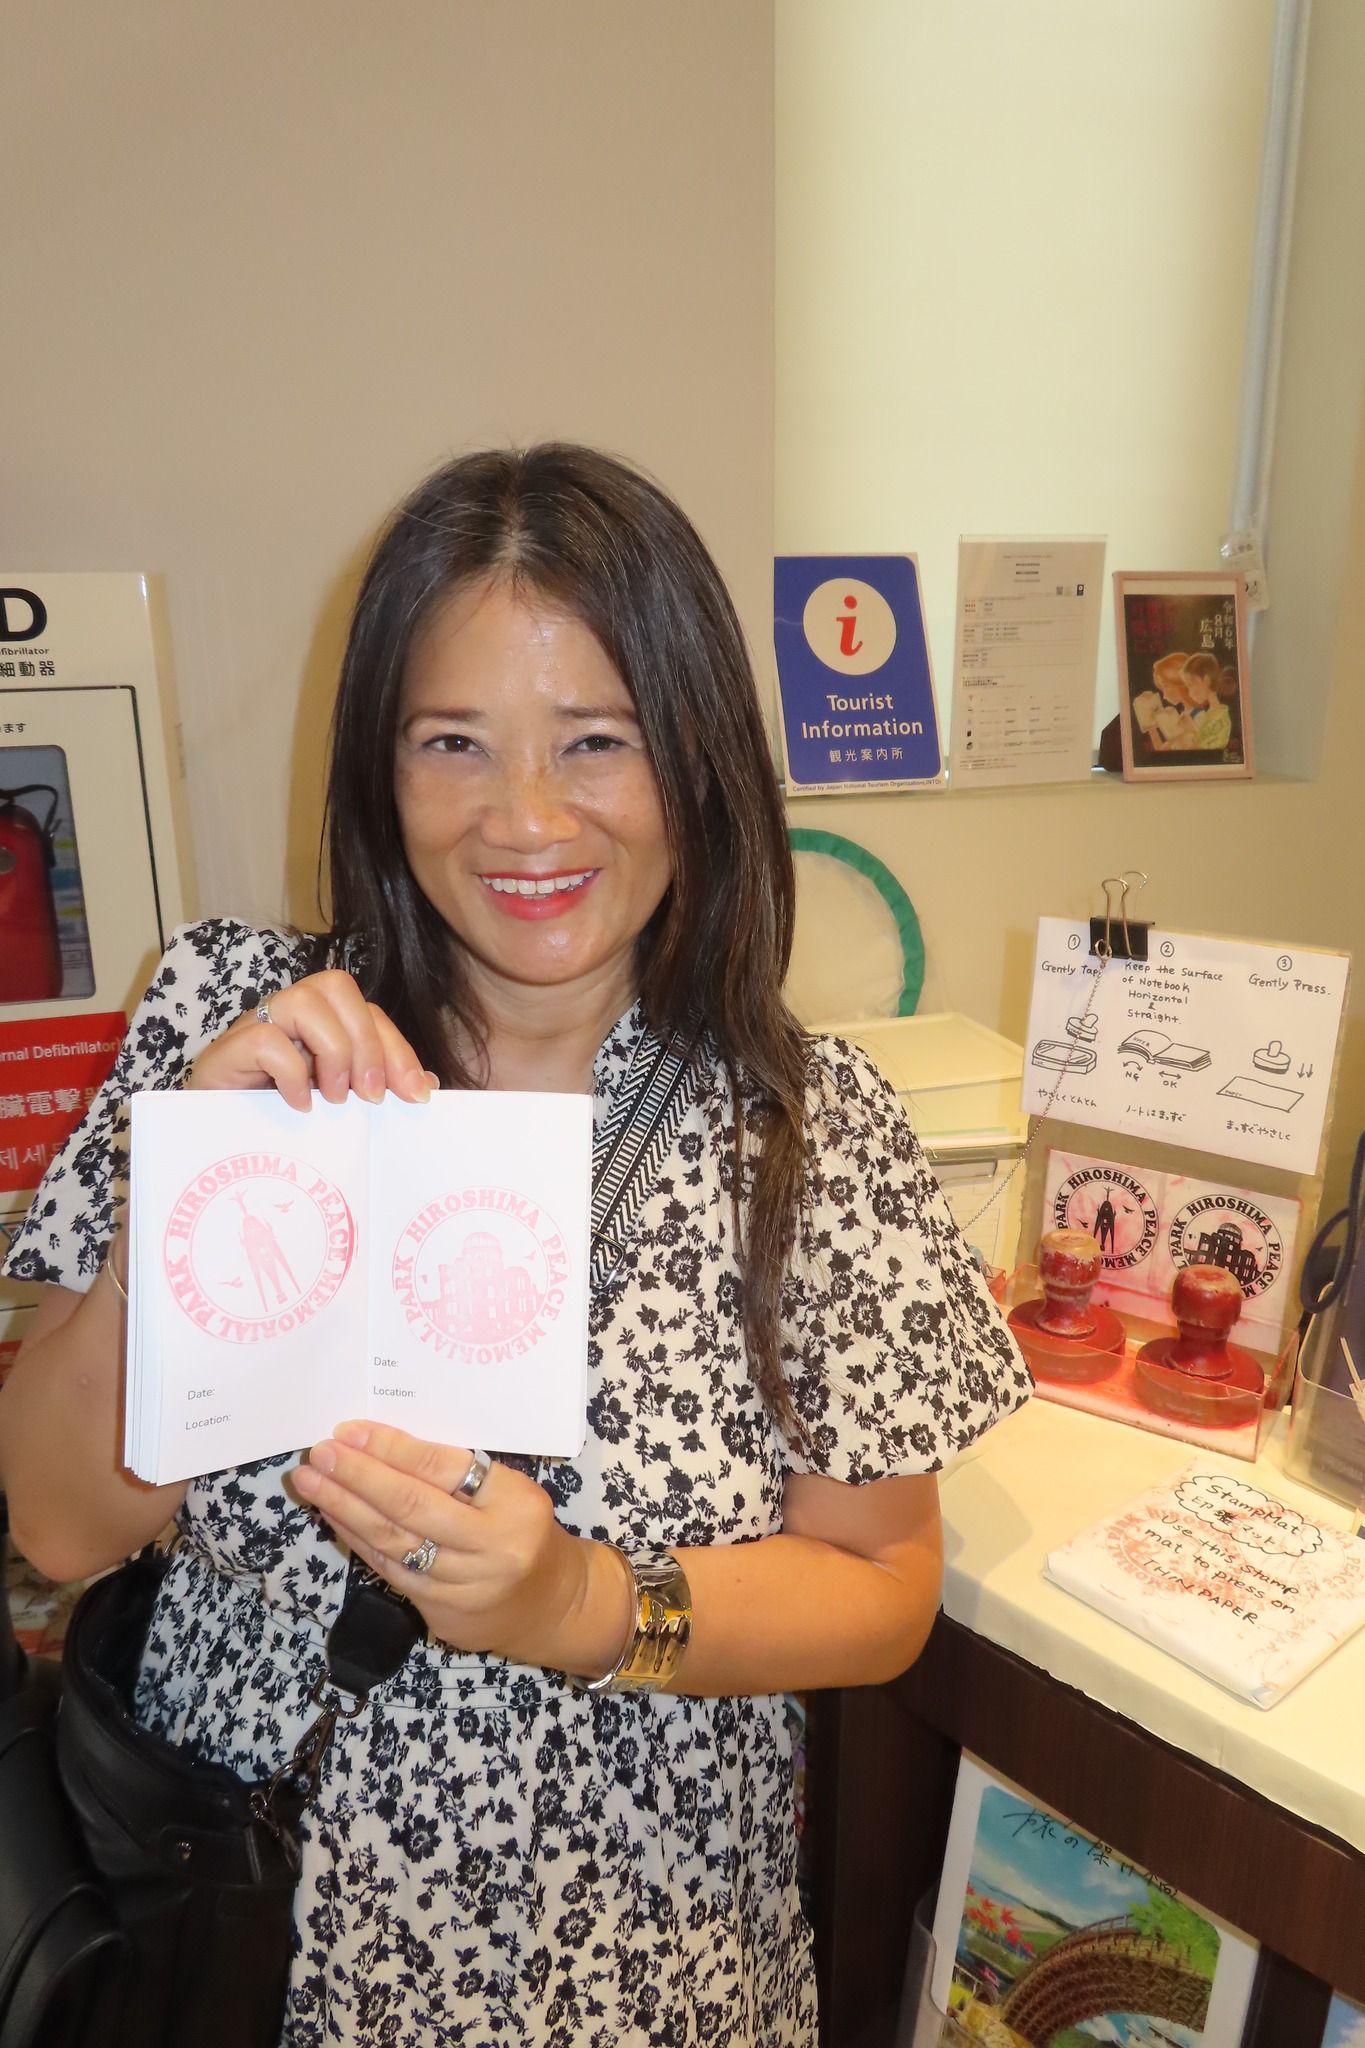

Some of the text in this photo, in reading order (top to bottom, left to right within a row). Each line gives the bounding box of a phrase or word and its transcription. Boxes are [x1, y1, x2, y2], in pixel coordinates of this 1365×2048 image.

[826, 693, 894, 711] Tourist
[802, 718, 923, 739] Information
[829, 747, 904, 763] 観光案内所
[1041, 960, 1077, 976] Gently
[1124, 961, 1151, 974] Keep
[1156, 964, 1176, 975] the
[1122, 975, 1190, 993] of Notebook
[1249, 973, 1290, 991] Gently
[1128, 990, 1188, 1004] Horizontal
[1125, 1071, 1140, 1082] NG
[1163, 1080, 1178, 1088] OK
[1226, 1119, 1291, 1141] まっすぐやさしく
[1067, 1169, 1147, 1203] HIROSHIMA
[1056, 1192, 1070, 1230] PARK
[1134, 1209, 1156, 1263] PEACE
[1171, 1196, 1281, 1290] HIROSHIMA PEACE PARK
[168, 1155, 350, 1342] HIROSHIMA PEACE MEMORIAL PARK
[394, 1189, 568, 1365] HIROSHIMA PEACE MEMORIAL PARK
[374, 1356, 399, 1368] Date:
[187, 1388, 215, 1401] Date:
[373, 1386, 416, 1399] Location:
[185, 1414, 232, 1431] Location:
[1161, 1514, 1194, 1538] Use
[1199, 1538, 1236, 1564] this
[1143, 1558, 1195, 1591] THIN
[1145, 1527, 1184, 1554] mat
[1192, 1552, 1210, 1569] to
[1271, 1599, 1296, 1614] on
